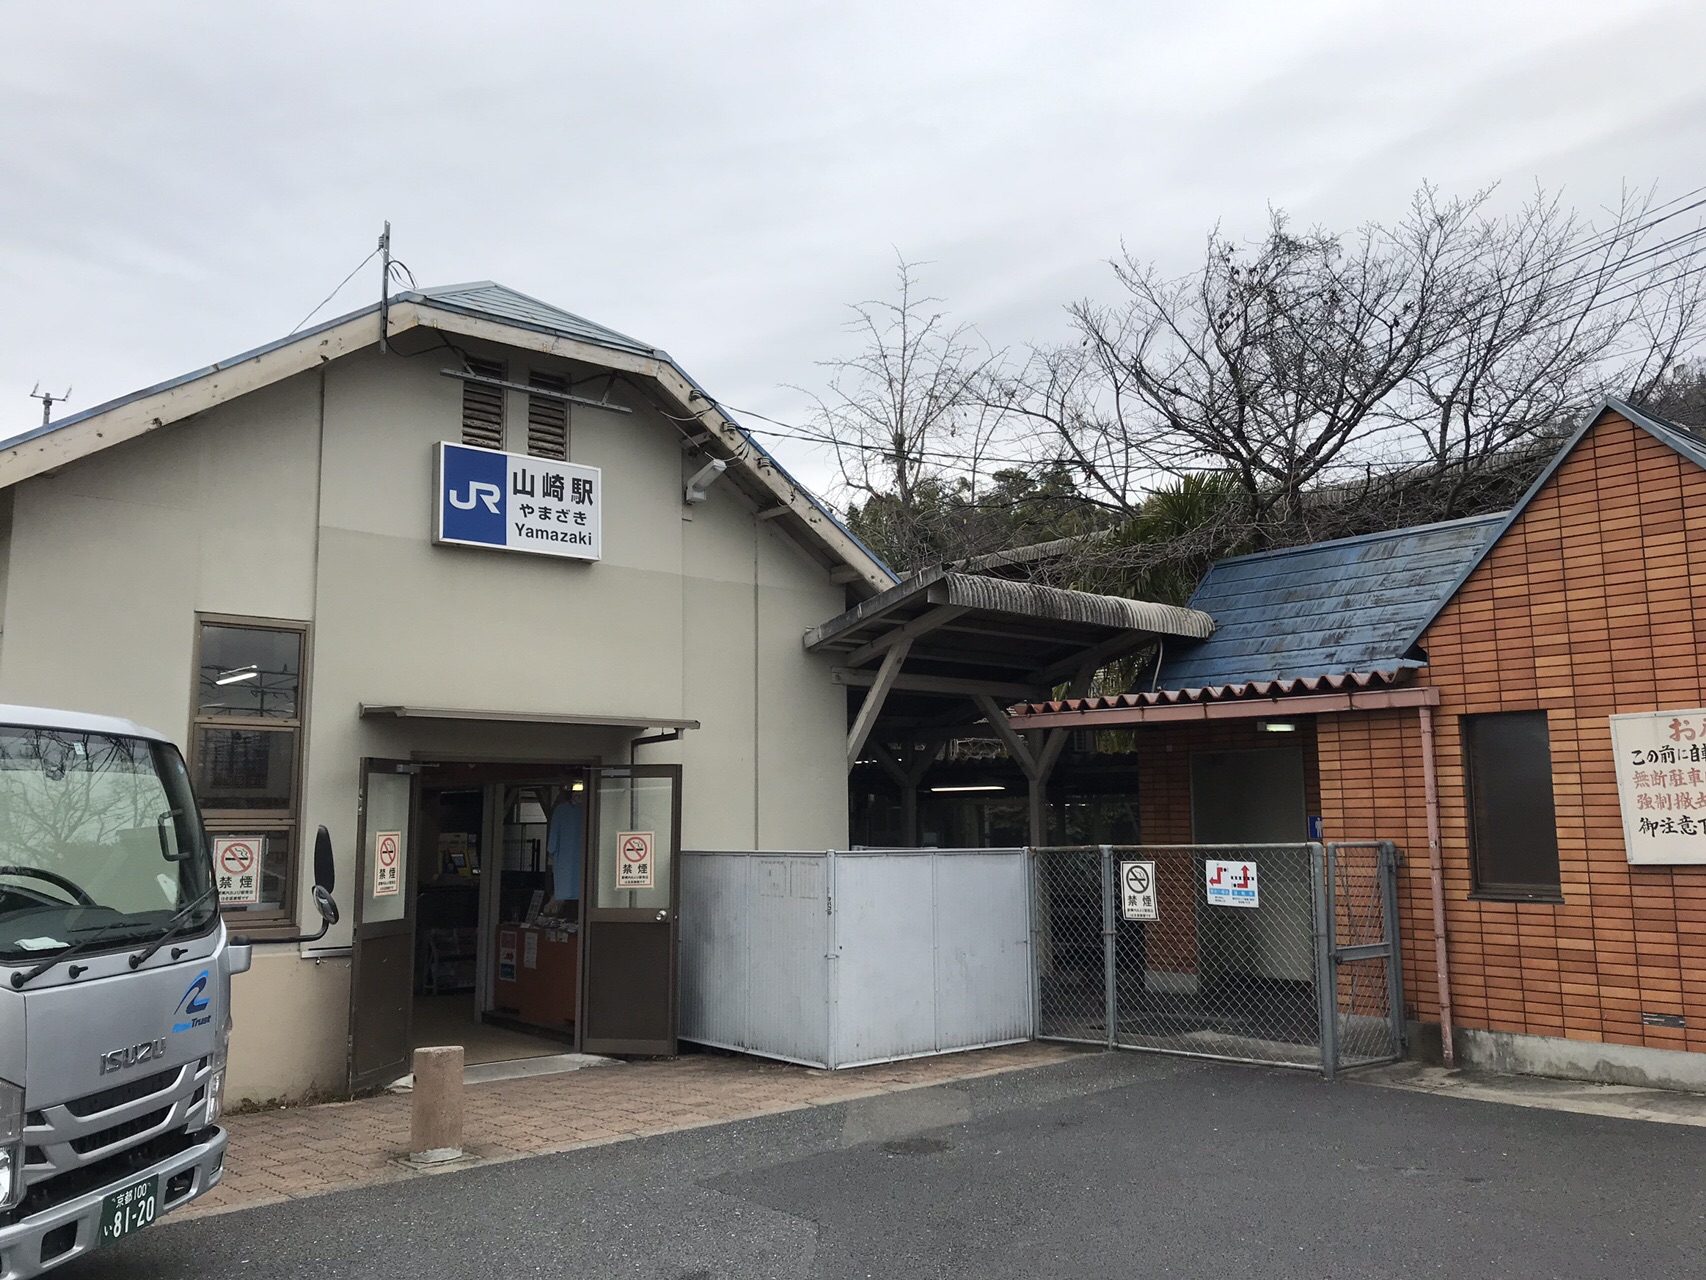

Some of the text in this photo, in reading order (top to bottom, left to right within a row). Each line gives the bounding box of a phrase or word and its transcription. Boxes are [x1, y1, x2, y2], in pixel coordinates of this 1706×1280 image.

[449, 480, 501, 515] JR
[512, 468, 594, 506] 山崎駅
[519, 503, 587, 526] やまざき
[515, 522, 592, 546] Yamazaki
[1632, 767, 1706, 789] 無断駐車
[379, 867, 396, 880] 禁煙
[623, 863, 648, 875] 禁煙
[219, 875, 253, 889] 禁煙
[1127, 894, 1153, 907] 禁煙
[99, 1036, 166, 1076] ISUZU
[113, 1196, 155, 1237] 81-20
